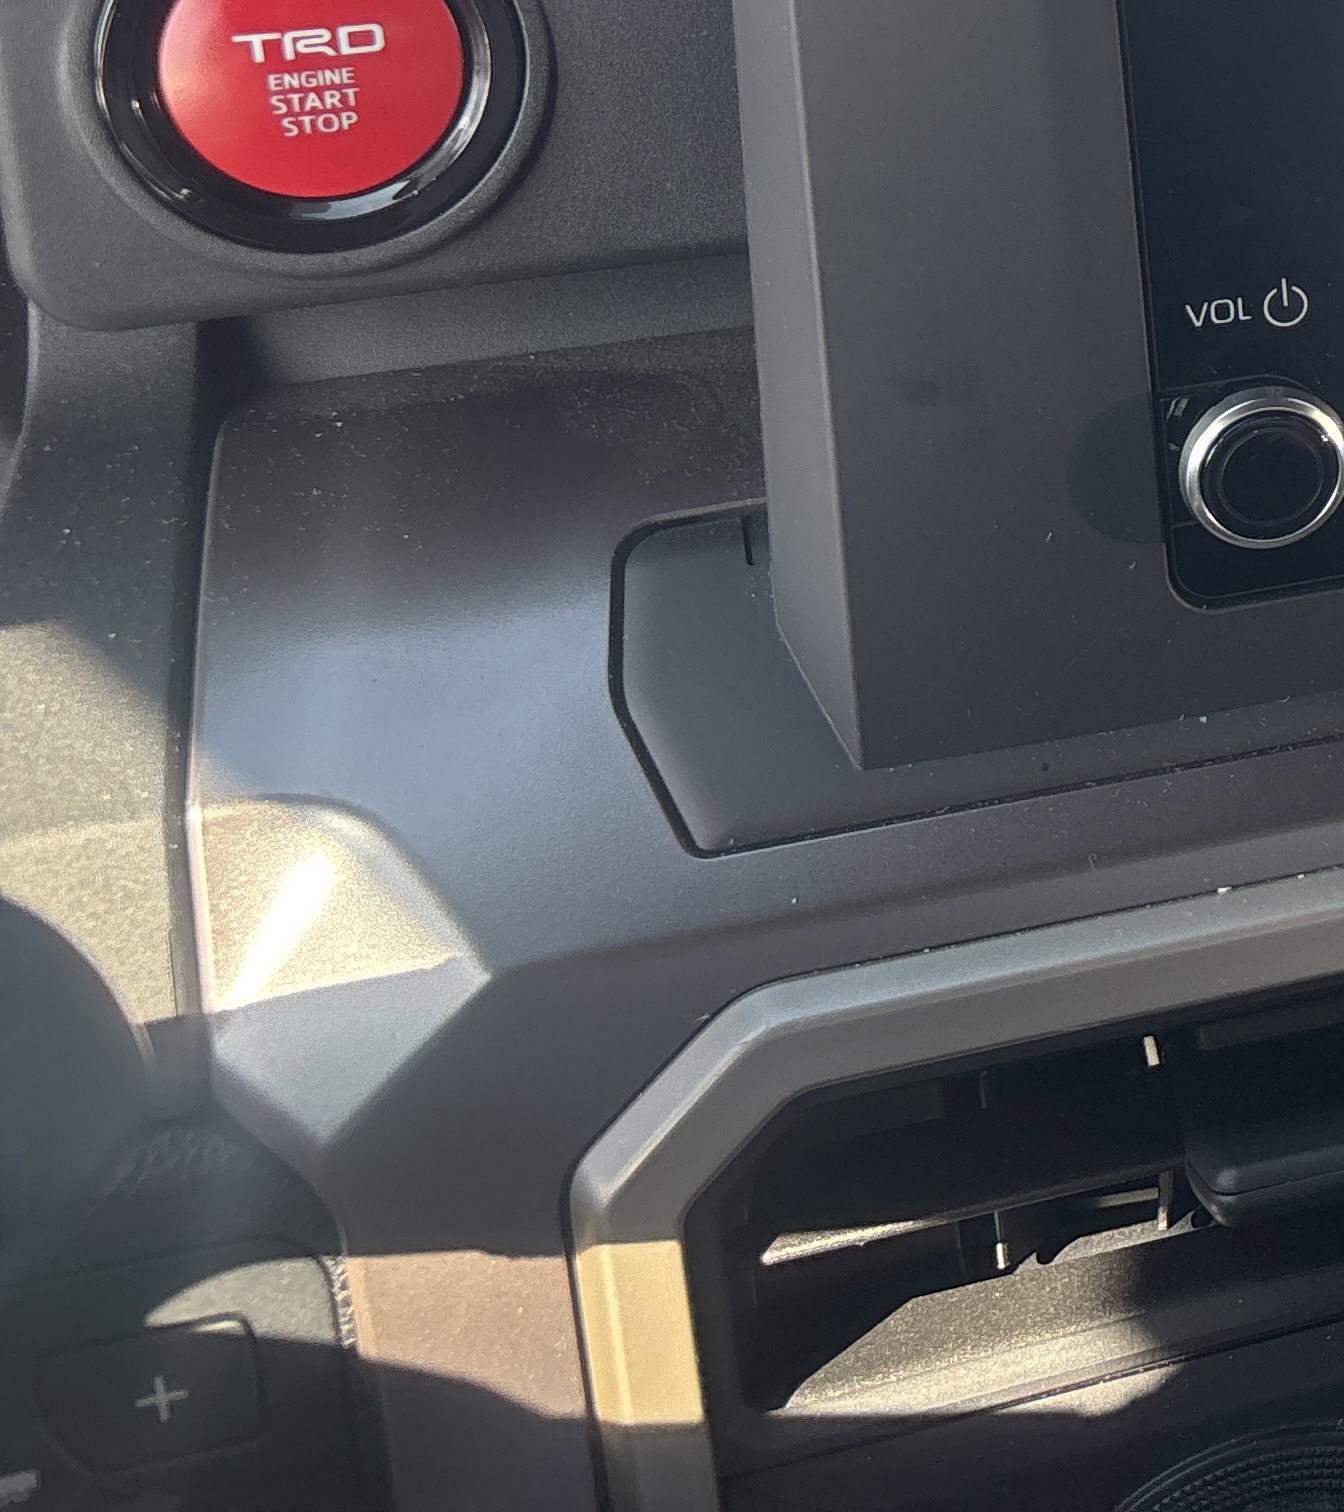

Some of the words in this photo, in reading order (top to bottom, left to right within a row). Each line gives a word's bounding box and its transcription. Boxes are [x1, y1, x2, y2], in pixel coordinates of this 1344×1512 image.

[231, 23, 385, 63] TRD
[267, 67, 356, 93] ENGINE
[269, 87, 362, 115] START
[282, 111, 359, 138] STOP
[1185, 296, 1252, 327] VOL
